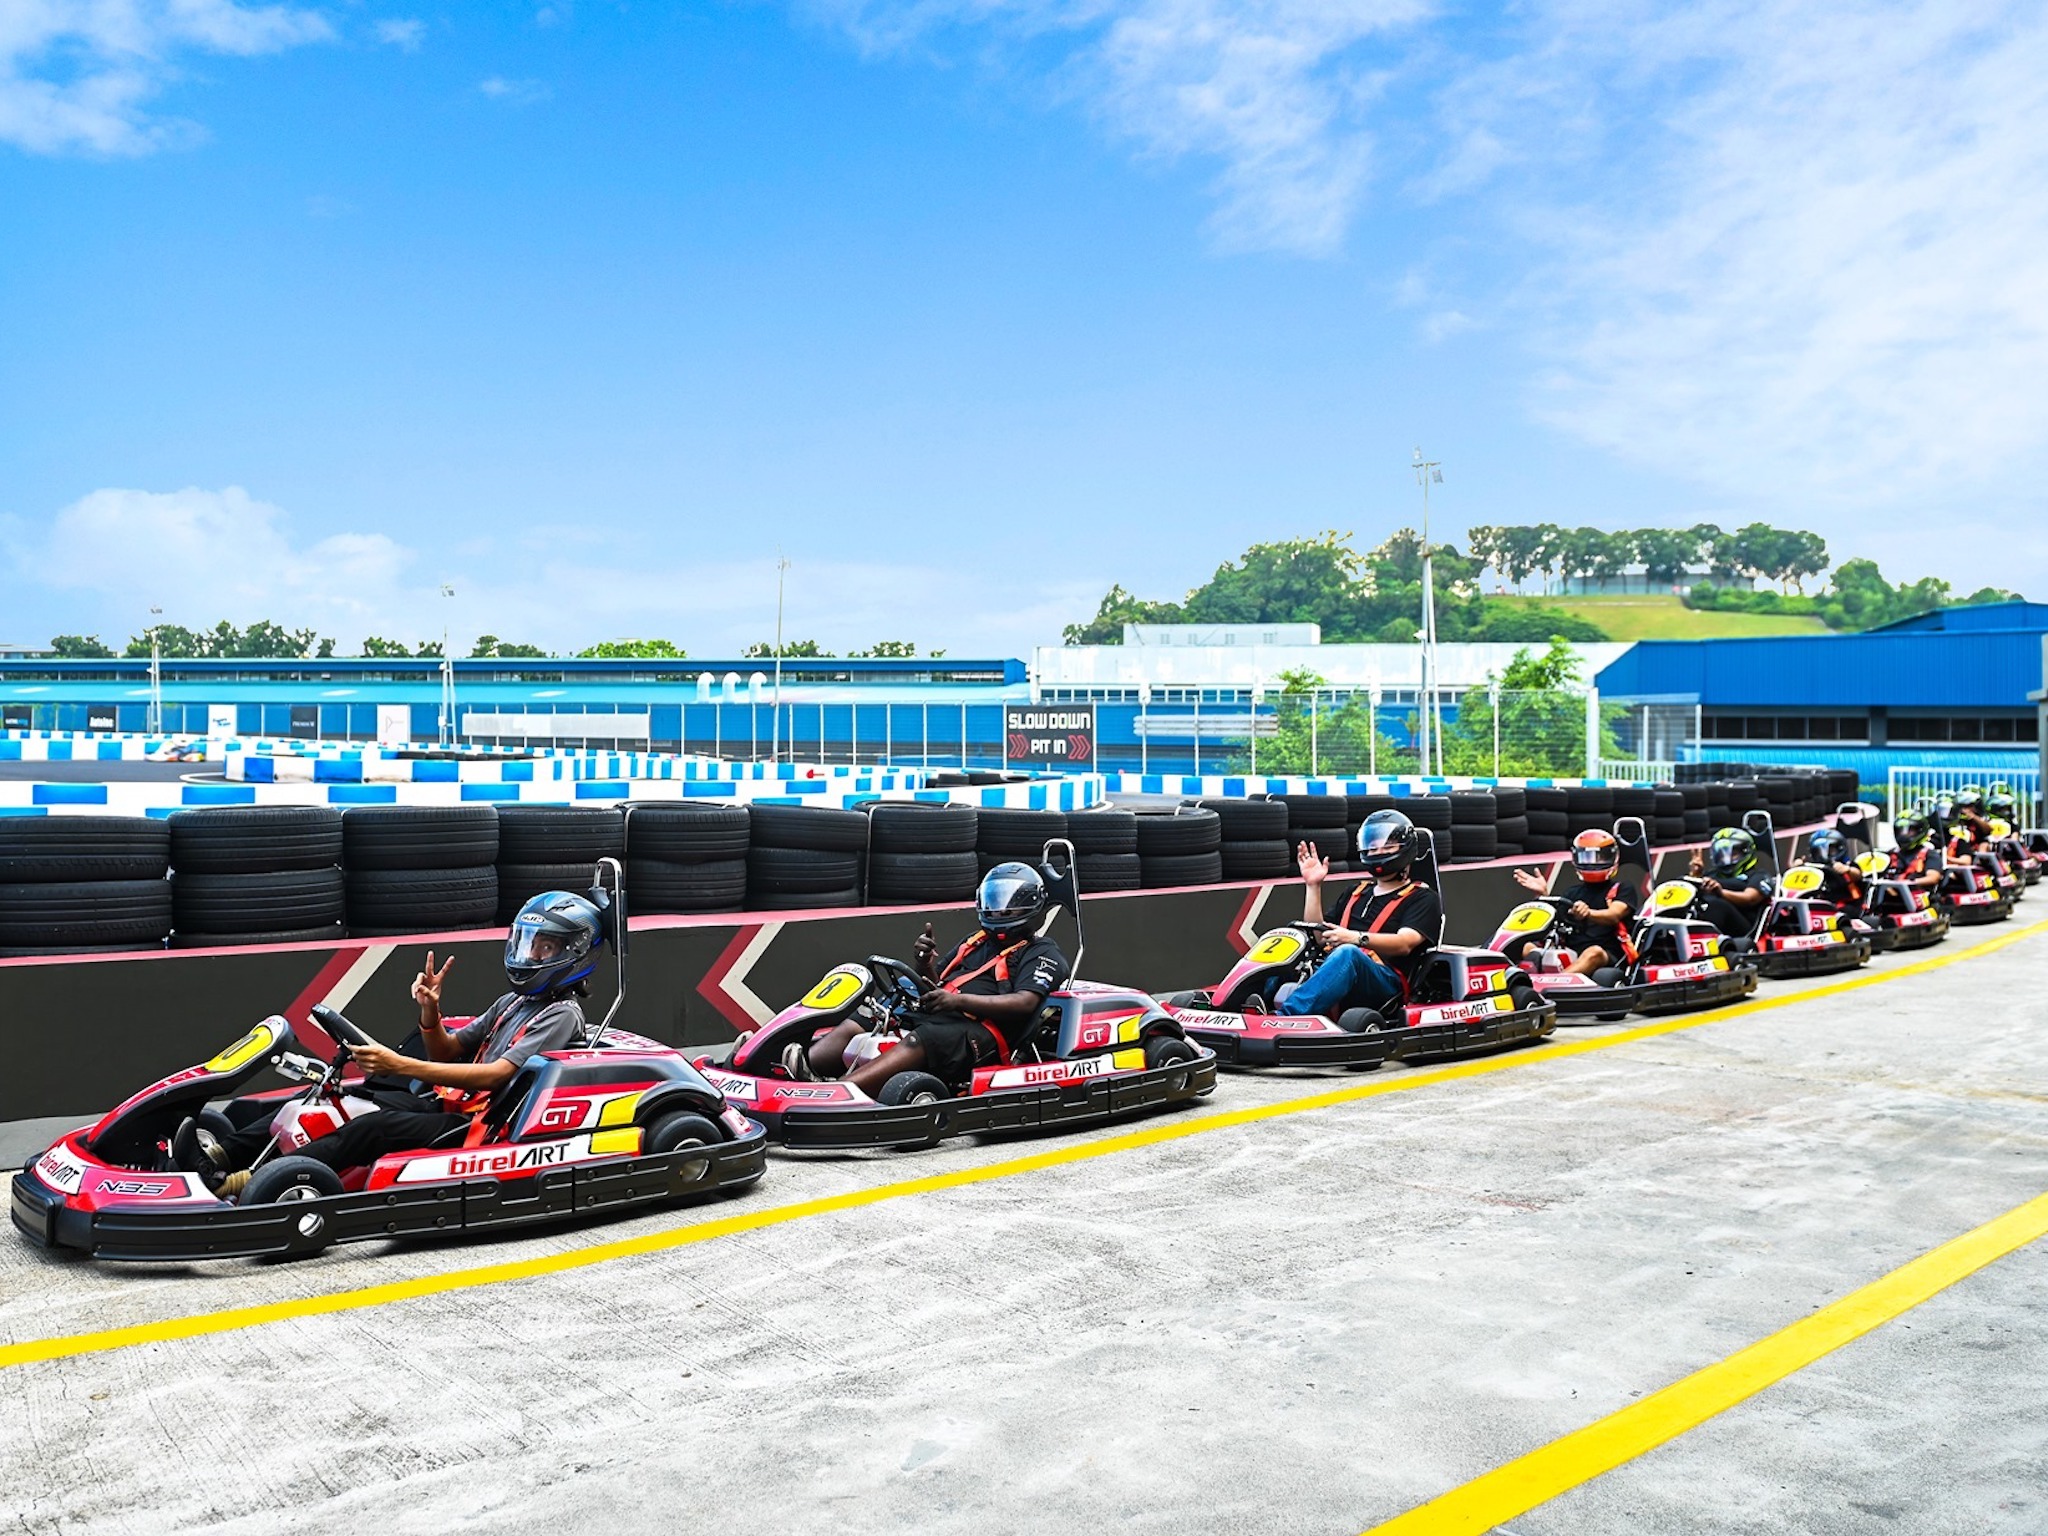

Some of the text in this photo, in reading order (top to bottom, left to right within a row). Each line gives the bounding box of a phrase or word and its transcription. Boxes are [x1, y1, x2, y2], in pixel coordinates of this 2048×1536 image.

[1008, 712, 1091, 729] SLOW DOWN
[1030, 739, 1067, 754] PIT IN
[1794, 874, 1809, 884] 14
[1518, 911, 1532, 925] 4
[1263, 937, 1283, 953] 2
[816, 978, 842, 999] 8
[1470, 978, 1484, 989] GT
[1083, 1027, 1106, 1044] GT
[541, 1105, 578, 1126] GT
